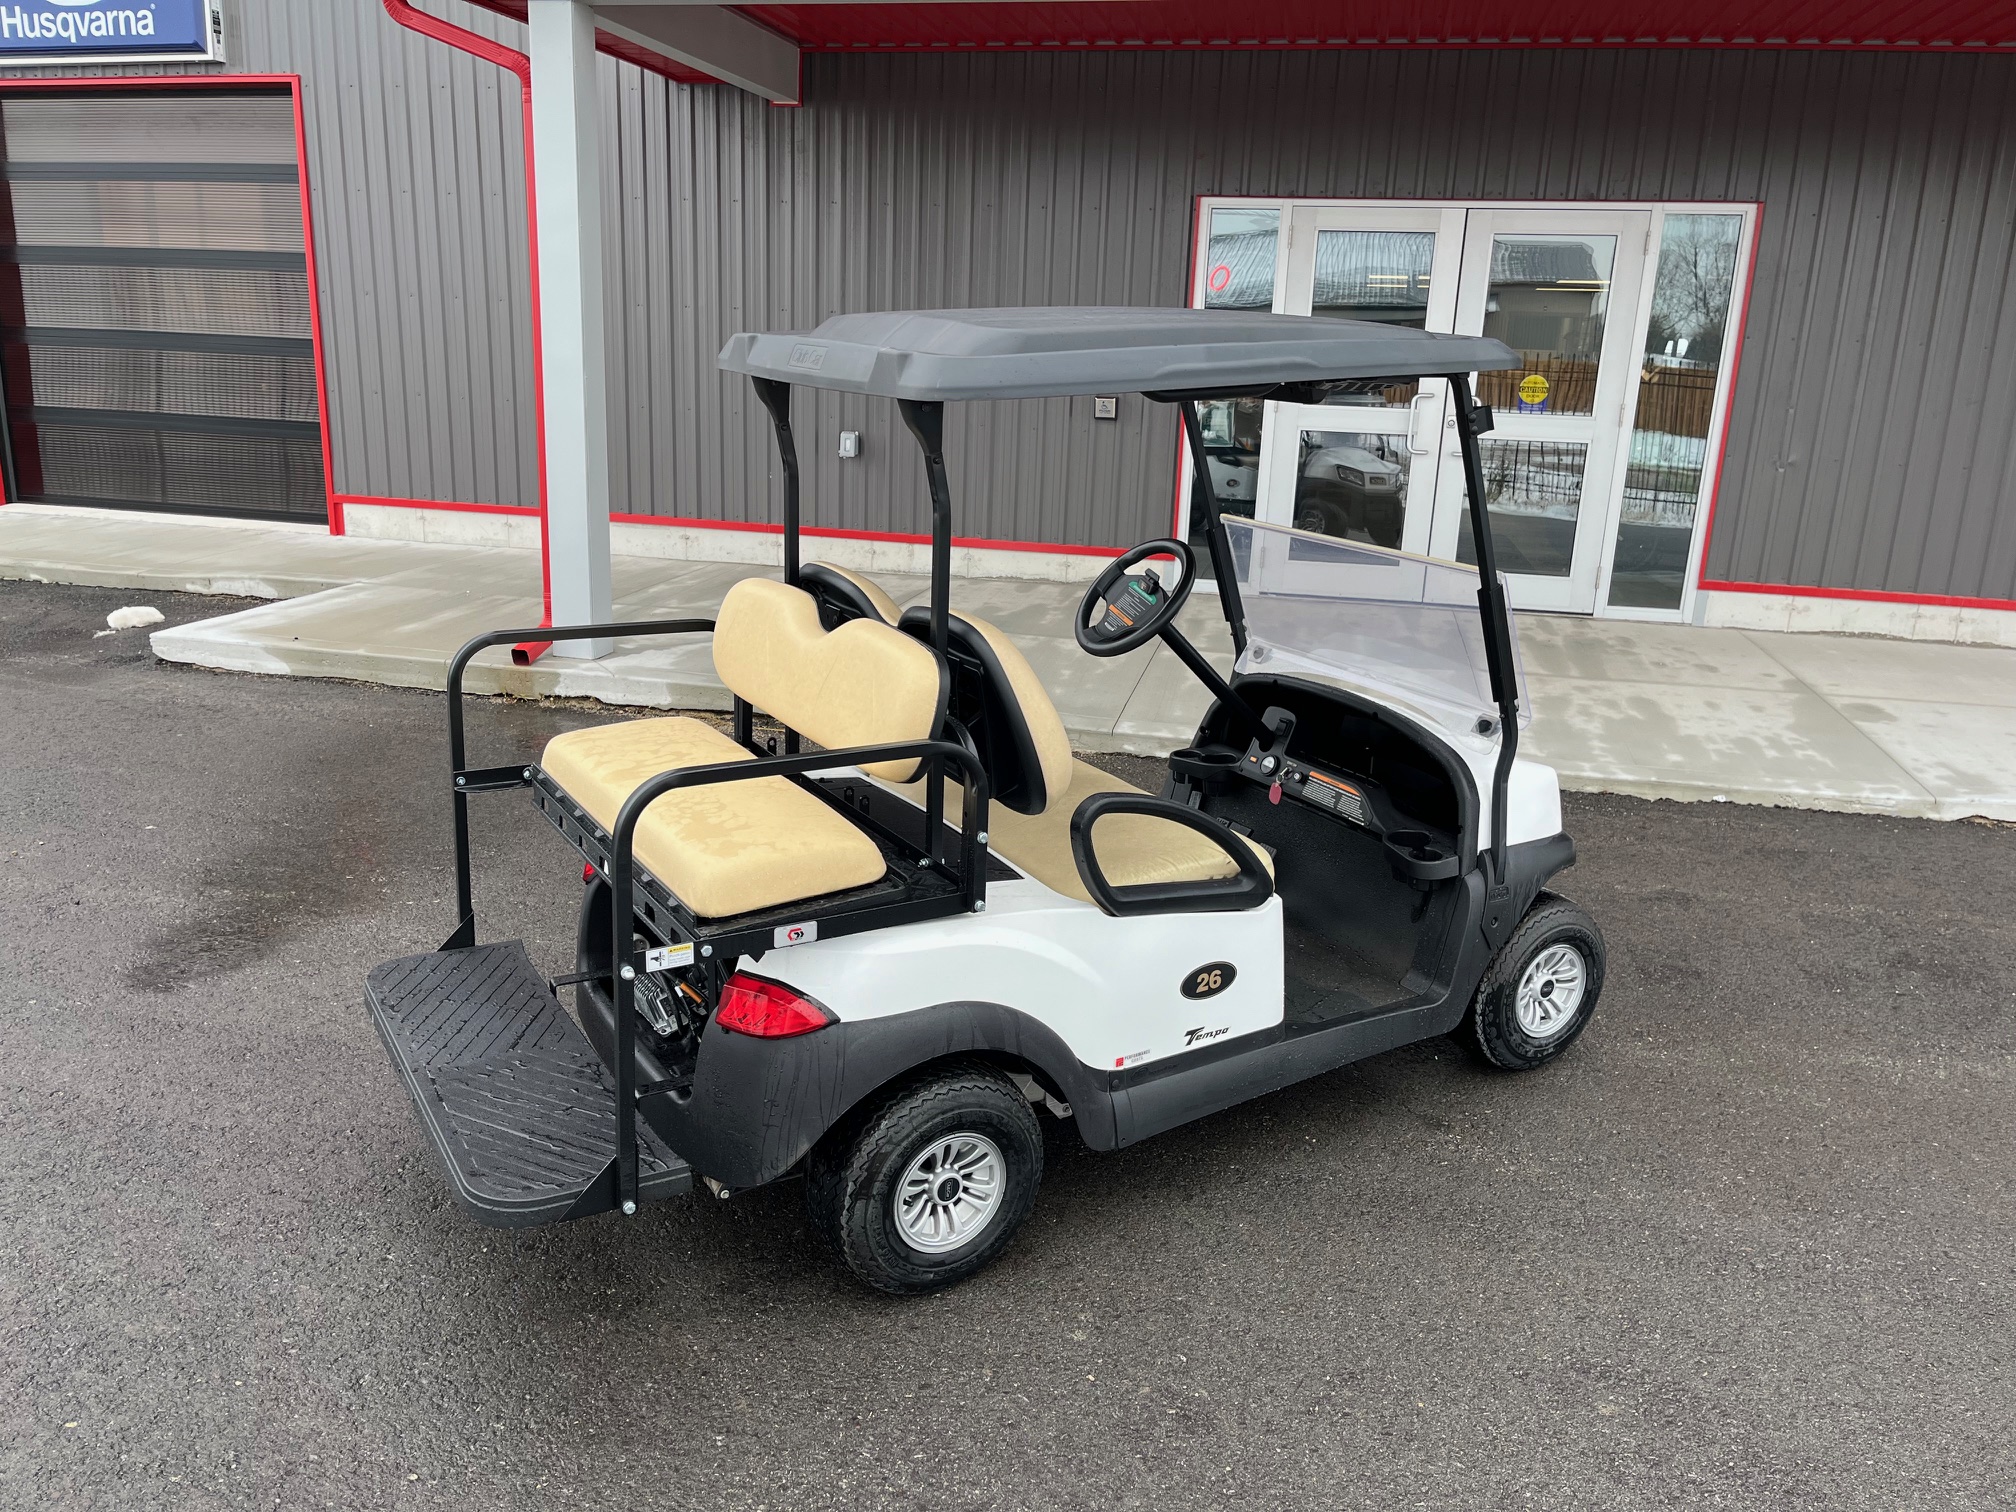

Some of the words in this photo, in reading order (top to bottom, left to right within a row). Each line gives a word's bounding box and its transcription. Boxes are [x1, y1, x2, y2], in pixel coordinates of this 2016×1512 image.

[0, 5, 155, 43] Husqvarna
[1196, 969, 1222, 993] 26
[1184, 1026, 1230, 1046] Tempo
